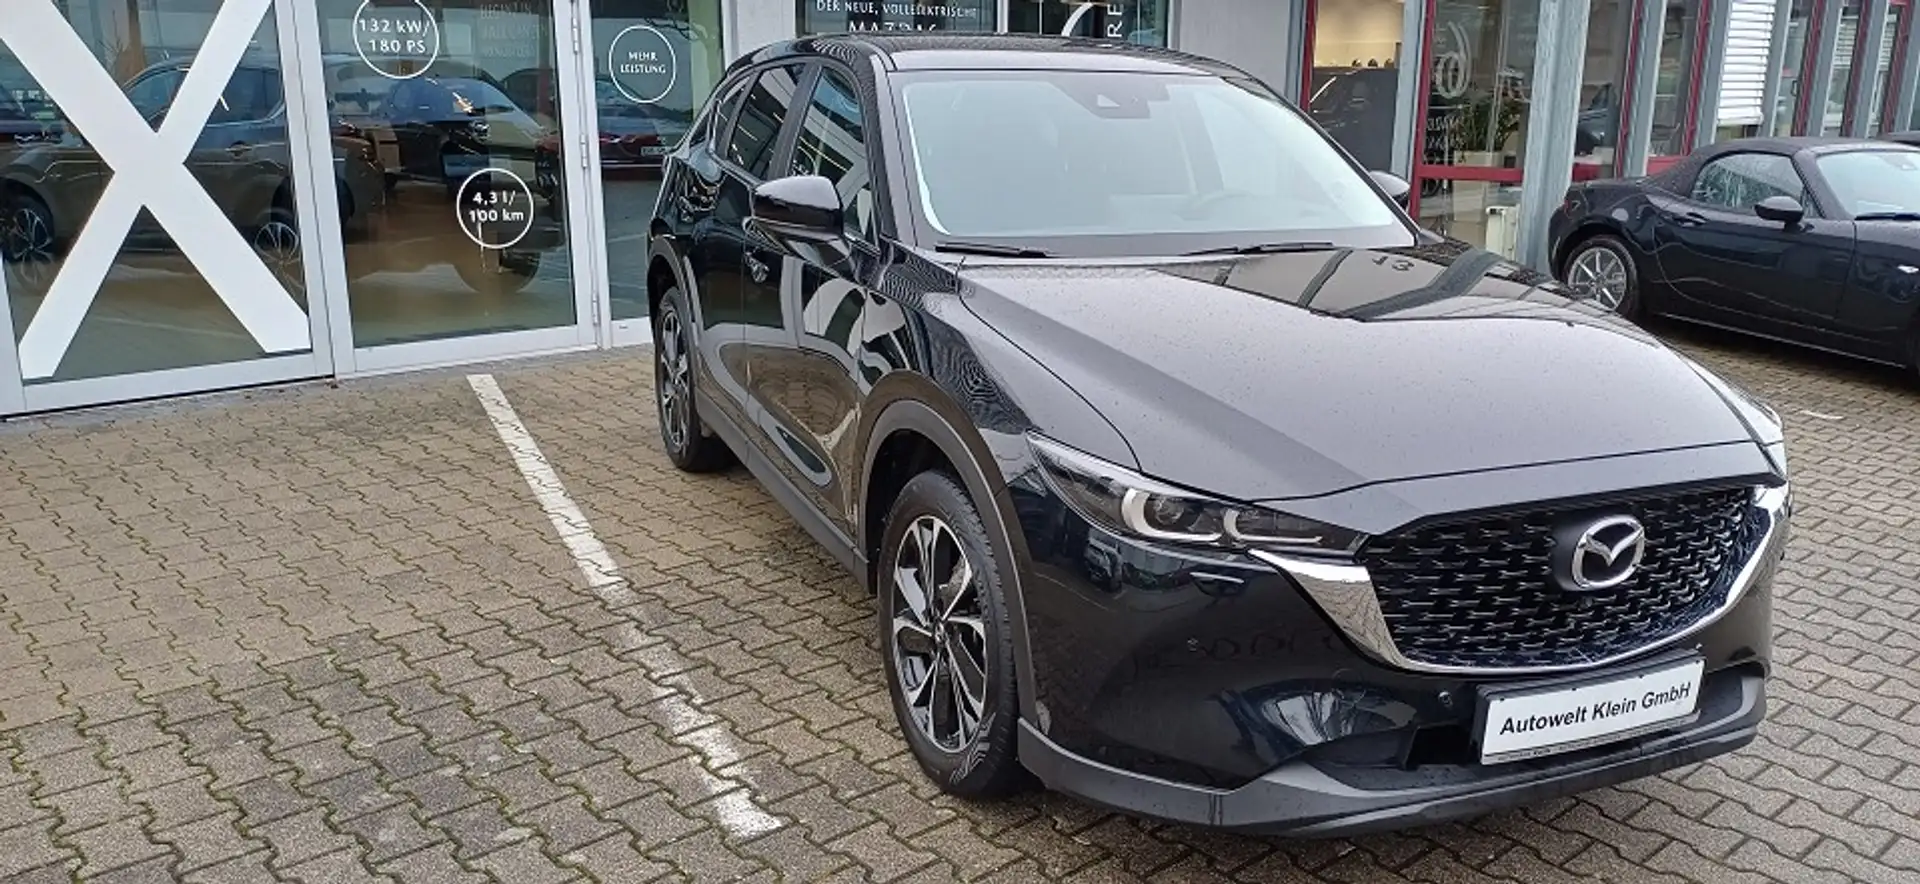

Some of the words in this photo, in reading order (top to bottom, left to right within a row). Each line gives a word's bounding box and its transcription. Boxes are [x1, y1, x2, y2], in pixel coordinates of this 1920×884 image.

[816, 0, 840, 12] DER
[844, 1, 879, 15] NEUE,
[358, 18, 391, 33] 132
[396, 19, 429, 37] kW/
[369, 38, 401, 53] 180
[406, 39, 426, 53] PS
[628, 51, 658, 61] MEHR
[620, 63, 666, 74] LEISTUNG
[469, 208, 498, 223] 100
[502, 208, 524, 221] km
[1500, 708, 1588, 735] Autowelt
[1591, 697, 1637, 721] Klein
[1641, 682, 1691, 710] GmbH
